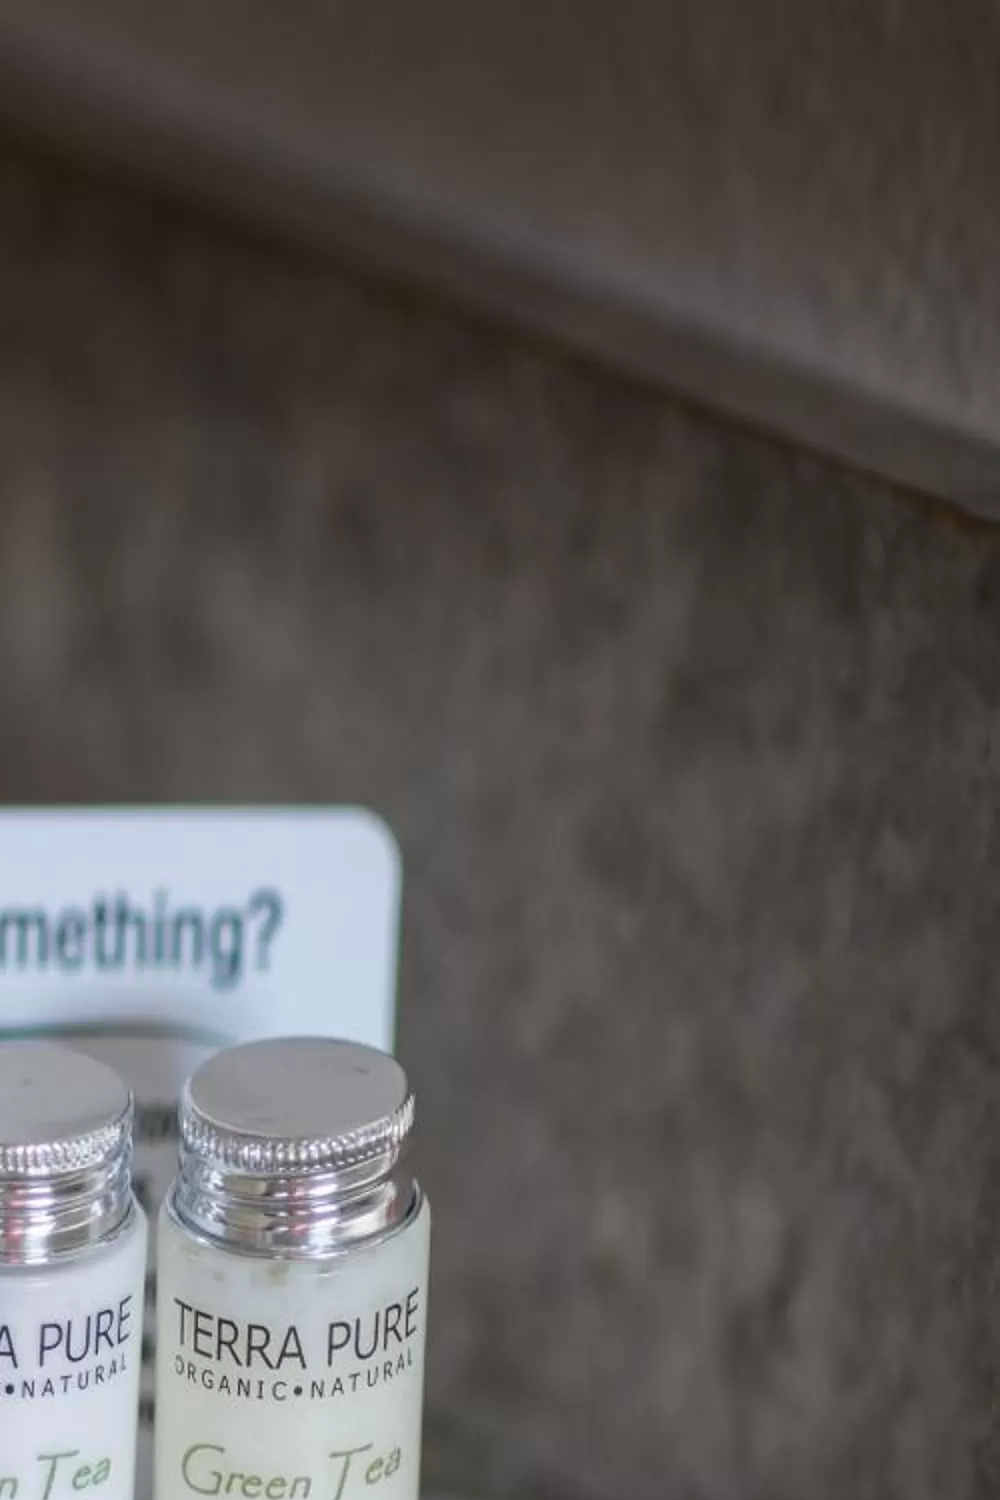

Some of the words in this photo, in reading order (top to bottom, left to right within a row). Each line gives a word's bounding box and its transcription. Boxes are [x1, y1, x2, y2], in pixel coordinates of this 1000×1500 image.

[39, 1295, 133, 1368] PURE
[174, 1297, 306, 1369] TERRA
[327, 1287, 419, 1366] PURE
[181, 1443, 312, 1500] Green
